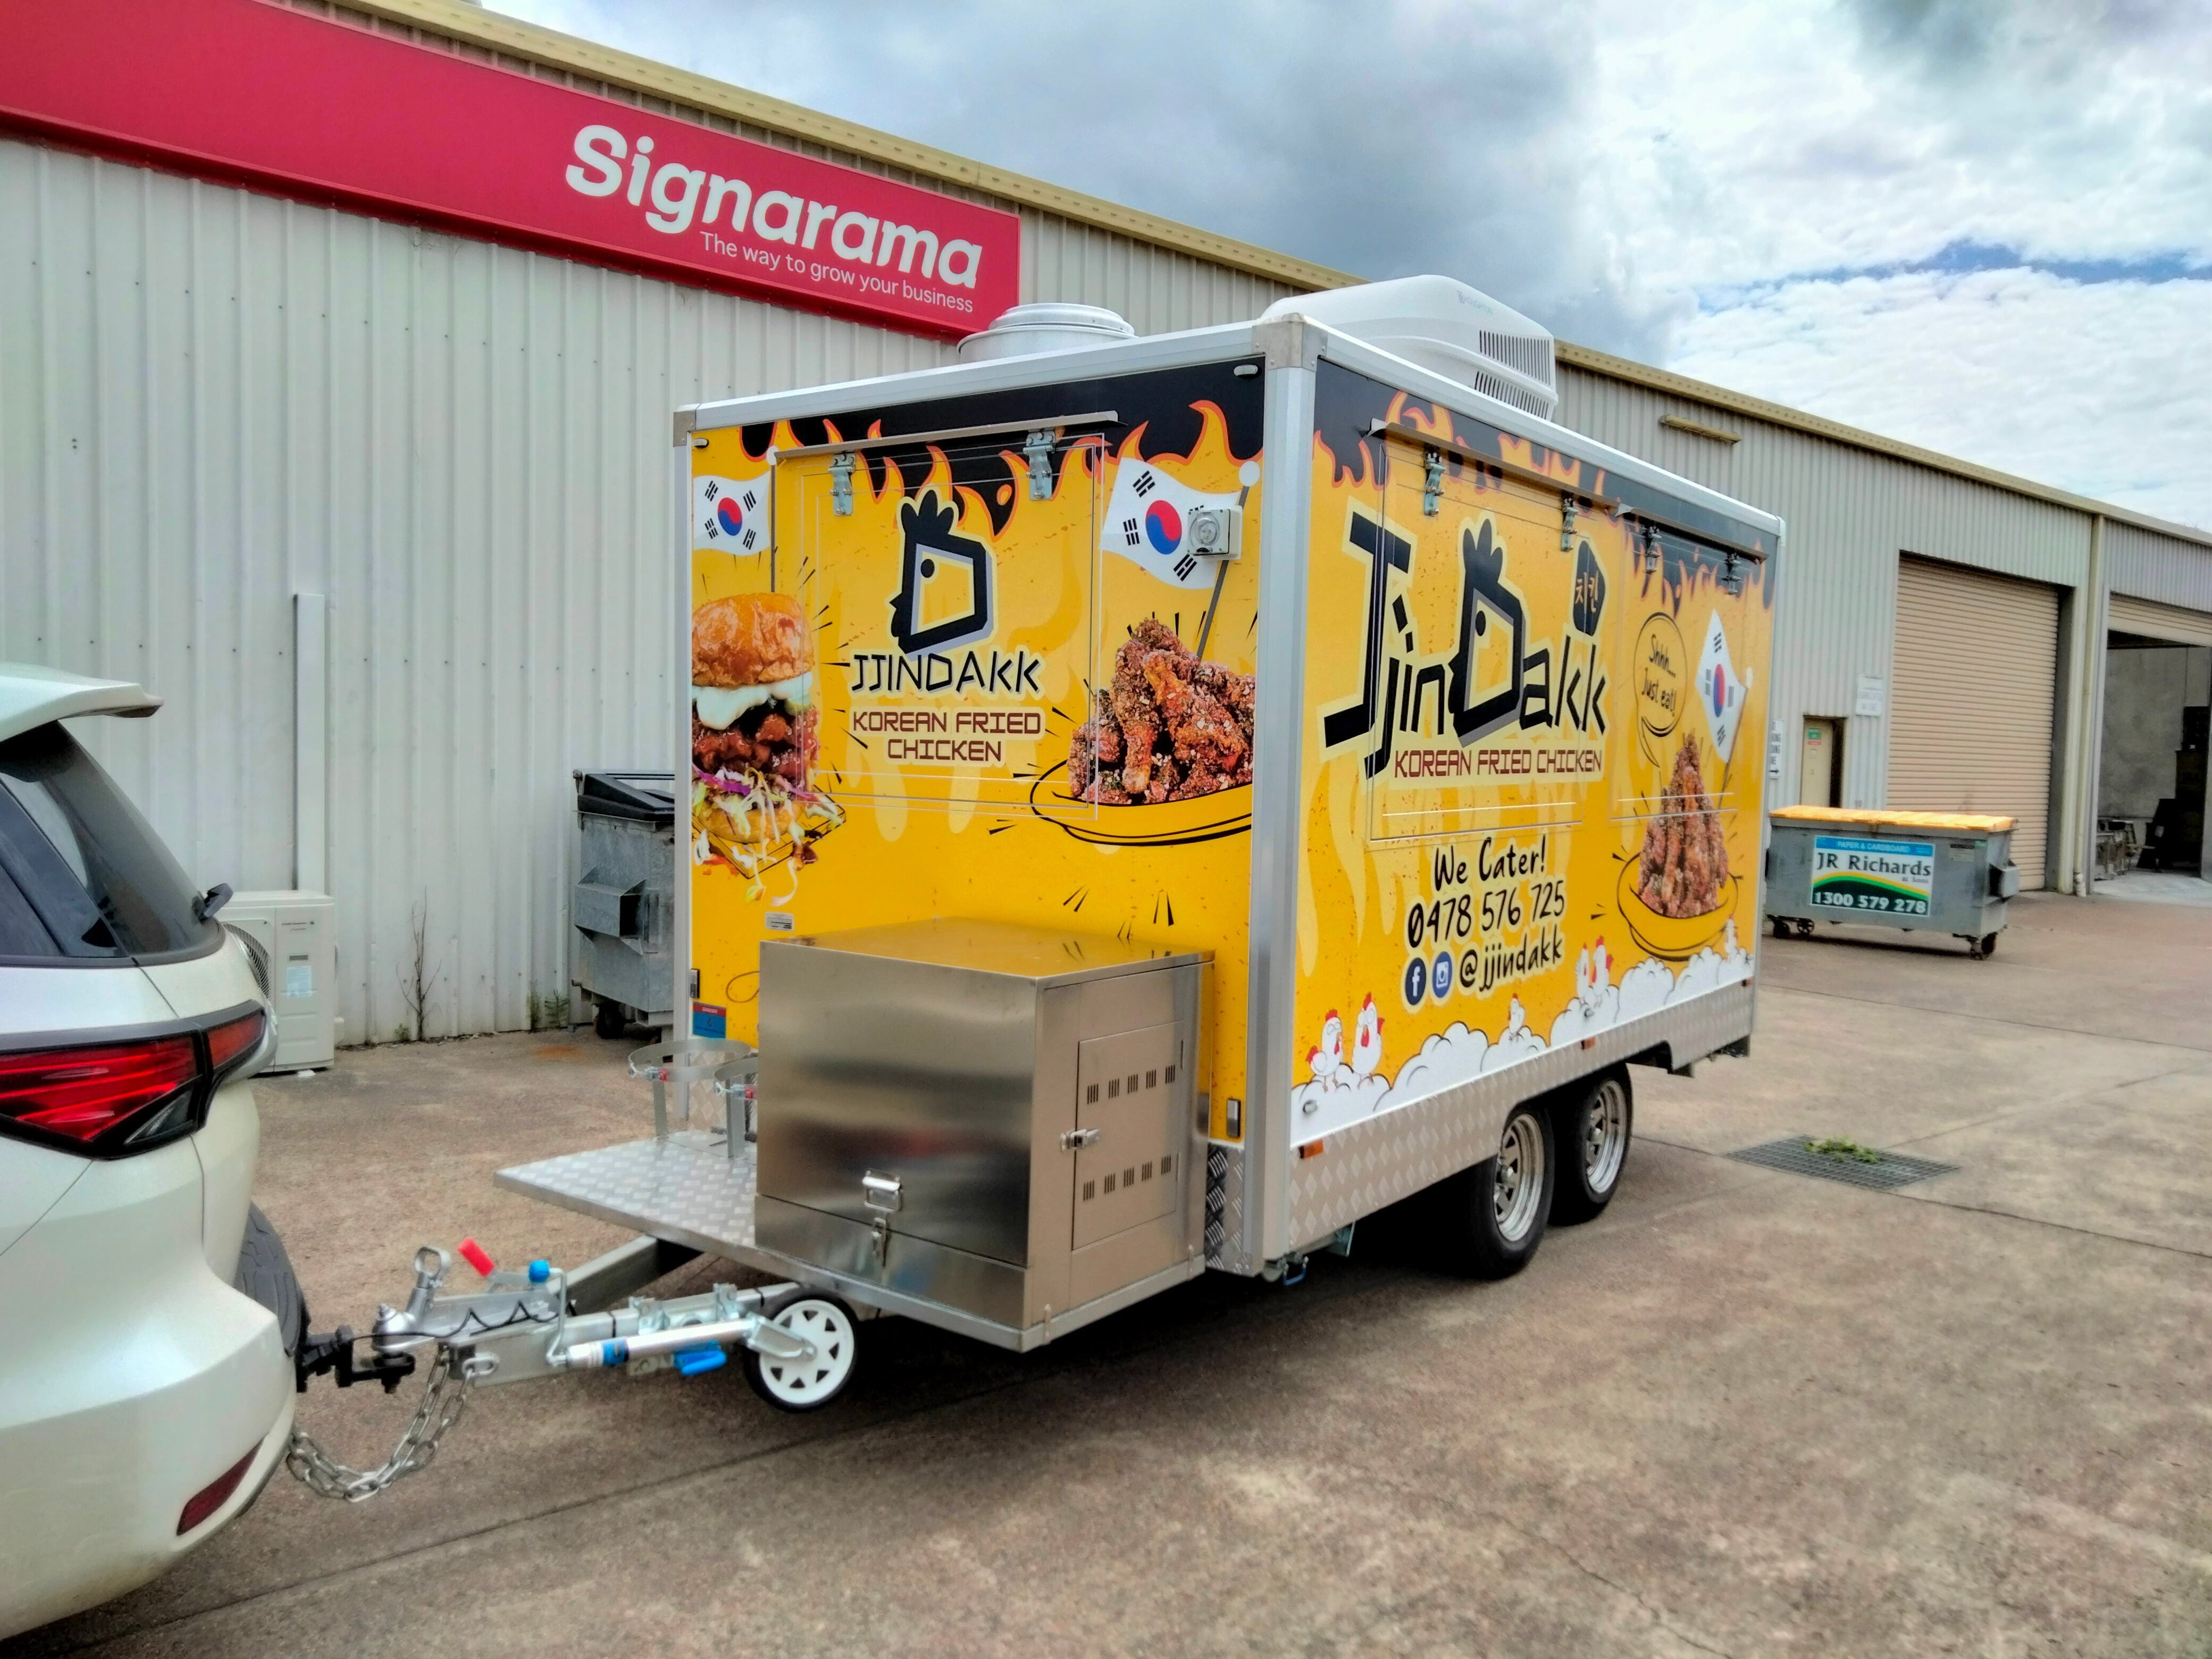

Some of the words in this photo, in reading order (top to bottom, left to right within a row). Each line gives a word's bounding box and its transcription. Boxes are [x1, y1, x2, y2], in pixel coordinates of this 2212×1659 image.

[565, 124, 983, 289] Signarama
[700, 231, 738, 258] The
[743, 246, 780, 271] way
[786, 253, 806, 274] to
[810, 262, 856, 285] grow
[859, 275, 900, 298] your
[902, 279, 974, 313] business
[1575, 571, 1598, 612] 치킨
[851, 650, 1040, 693] JJINDAKK
[1641, 667, 1659, 703] Just
[1661, 688, 1677, 717] eat!
[853, 711, 947, 733] KOREAN
[956, 712, 1041, 734] FRIED
[887, 739, 1002, 761] CHICKEN
[1395, 750, 1472, 778] KOREAN
[1477, 750, 1532, 775] FRIED
[1537, 749, 1602, 773] CHICKEN
[1435, 844, 1468, 891] We
[1479, 834, 1546, 881] Cater!
[1816, 852, 1839, 870] JR
[1848, 854, 1931, 876] Richards
[1867, 843, 1911, 852] CARDBOARD
[1408, 894, 1471, 948] 0478
[1482, 887, 1521, 931] 576
[1531, 880, 1565, 923] 725
[1814, 892, 1854, 907] 1300
[1858, 895, 1889, 910] 579
[1894, 899, 1926, 913] 278
[1460, 923, 1562, 992] @jjindakk
